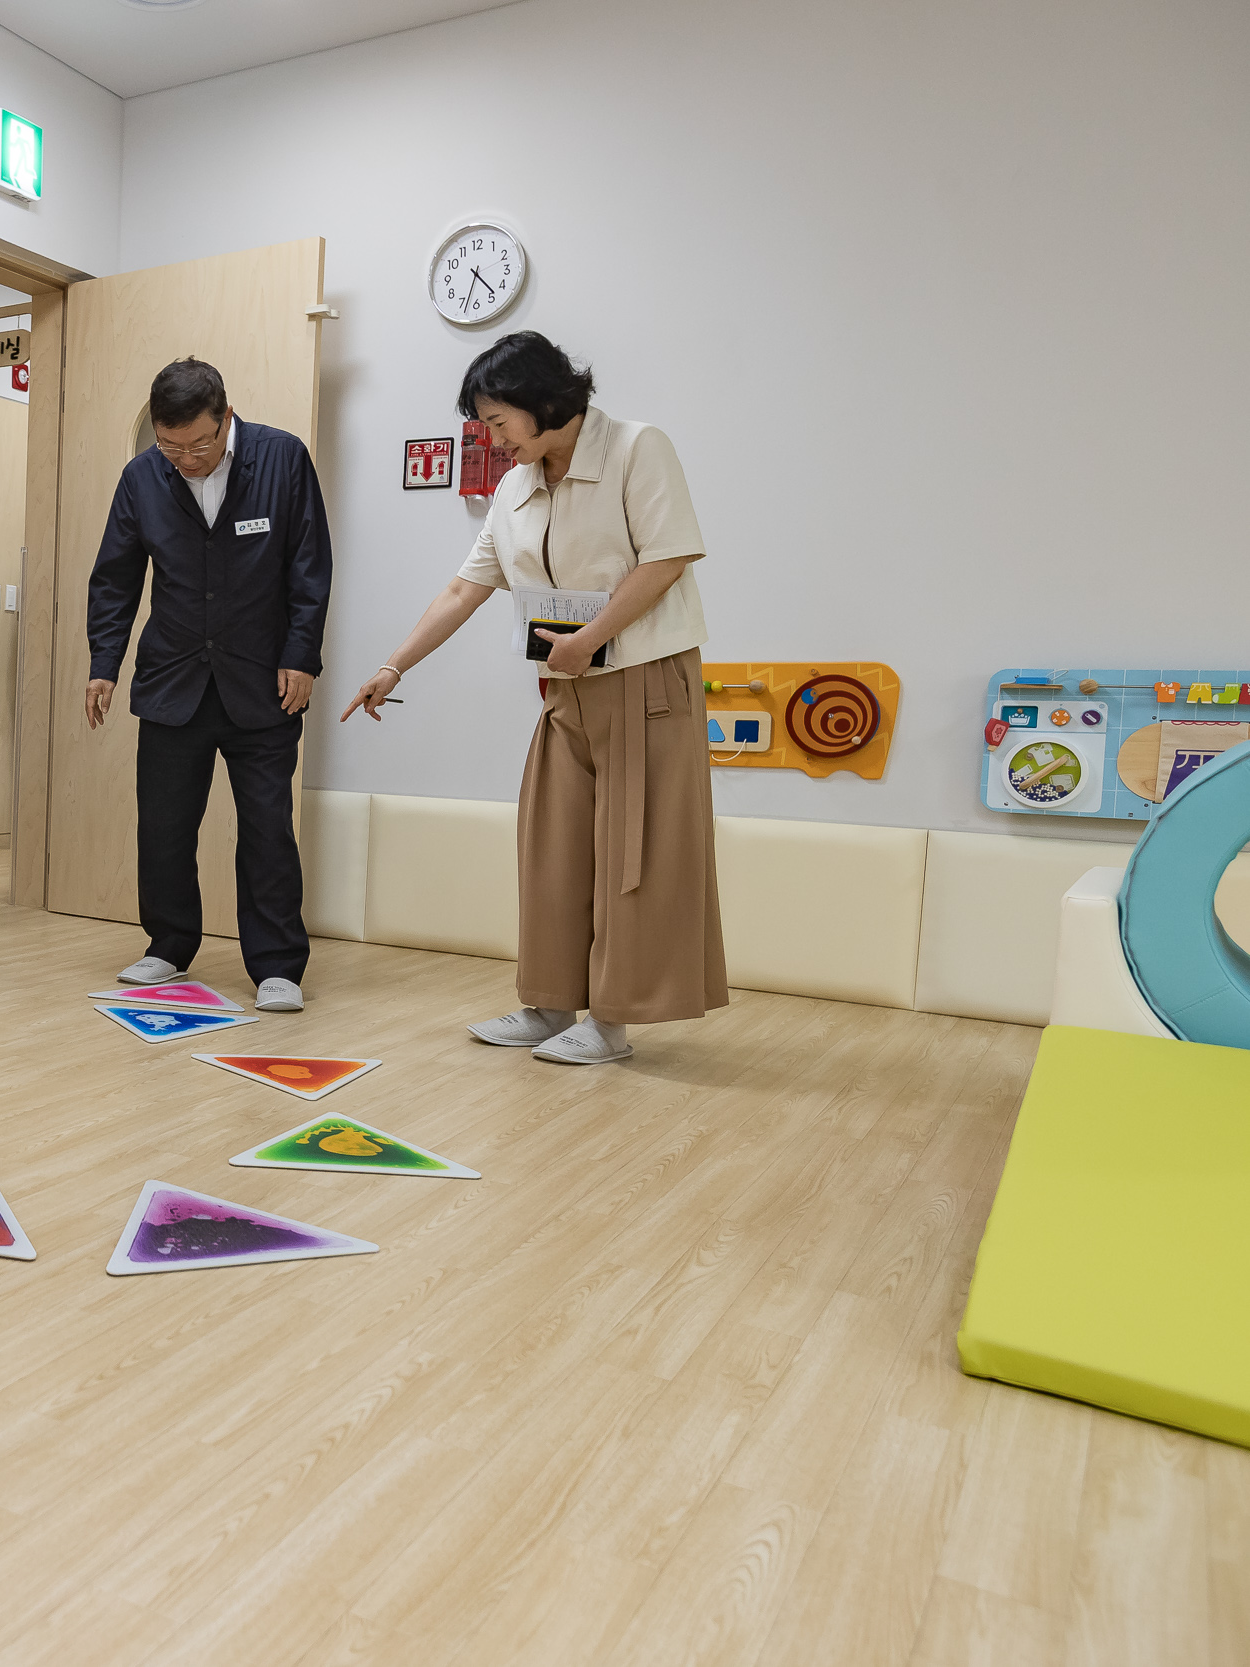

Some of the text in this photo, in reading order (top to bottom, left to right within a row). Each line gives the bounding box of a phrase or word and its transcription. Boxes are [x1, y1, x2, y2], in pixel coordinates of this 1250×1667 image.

[472, 238, 483, 250] 12
[491, 241, 496, 252] 1
[459, 246, 467, 258] 11
[500, 249, 508, 261] 2
[447, 258, 459, 270] 10
[503, 264, 510, 275] 3
[444, 274, 452, 286] 9
[498, 279, 506, 290] 4
[448, 288, 455, 299] 8
[488, 293, 496, 303] 5
[458, 298, 466, 308] 7
[472, 298, 480, 310] 6
[410, 443, 447, 453] 소화기
